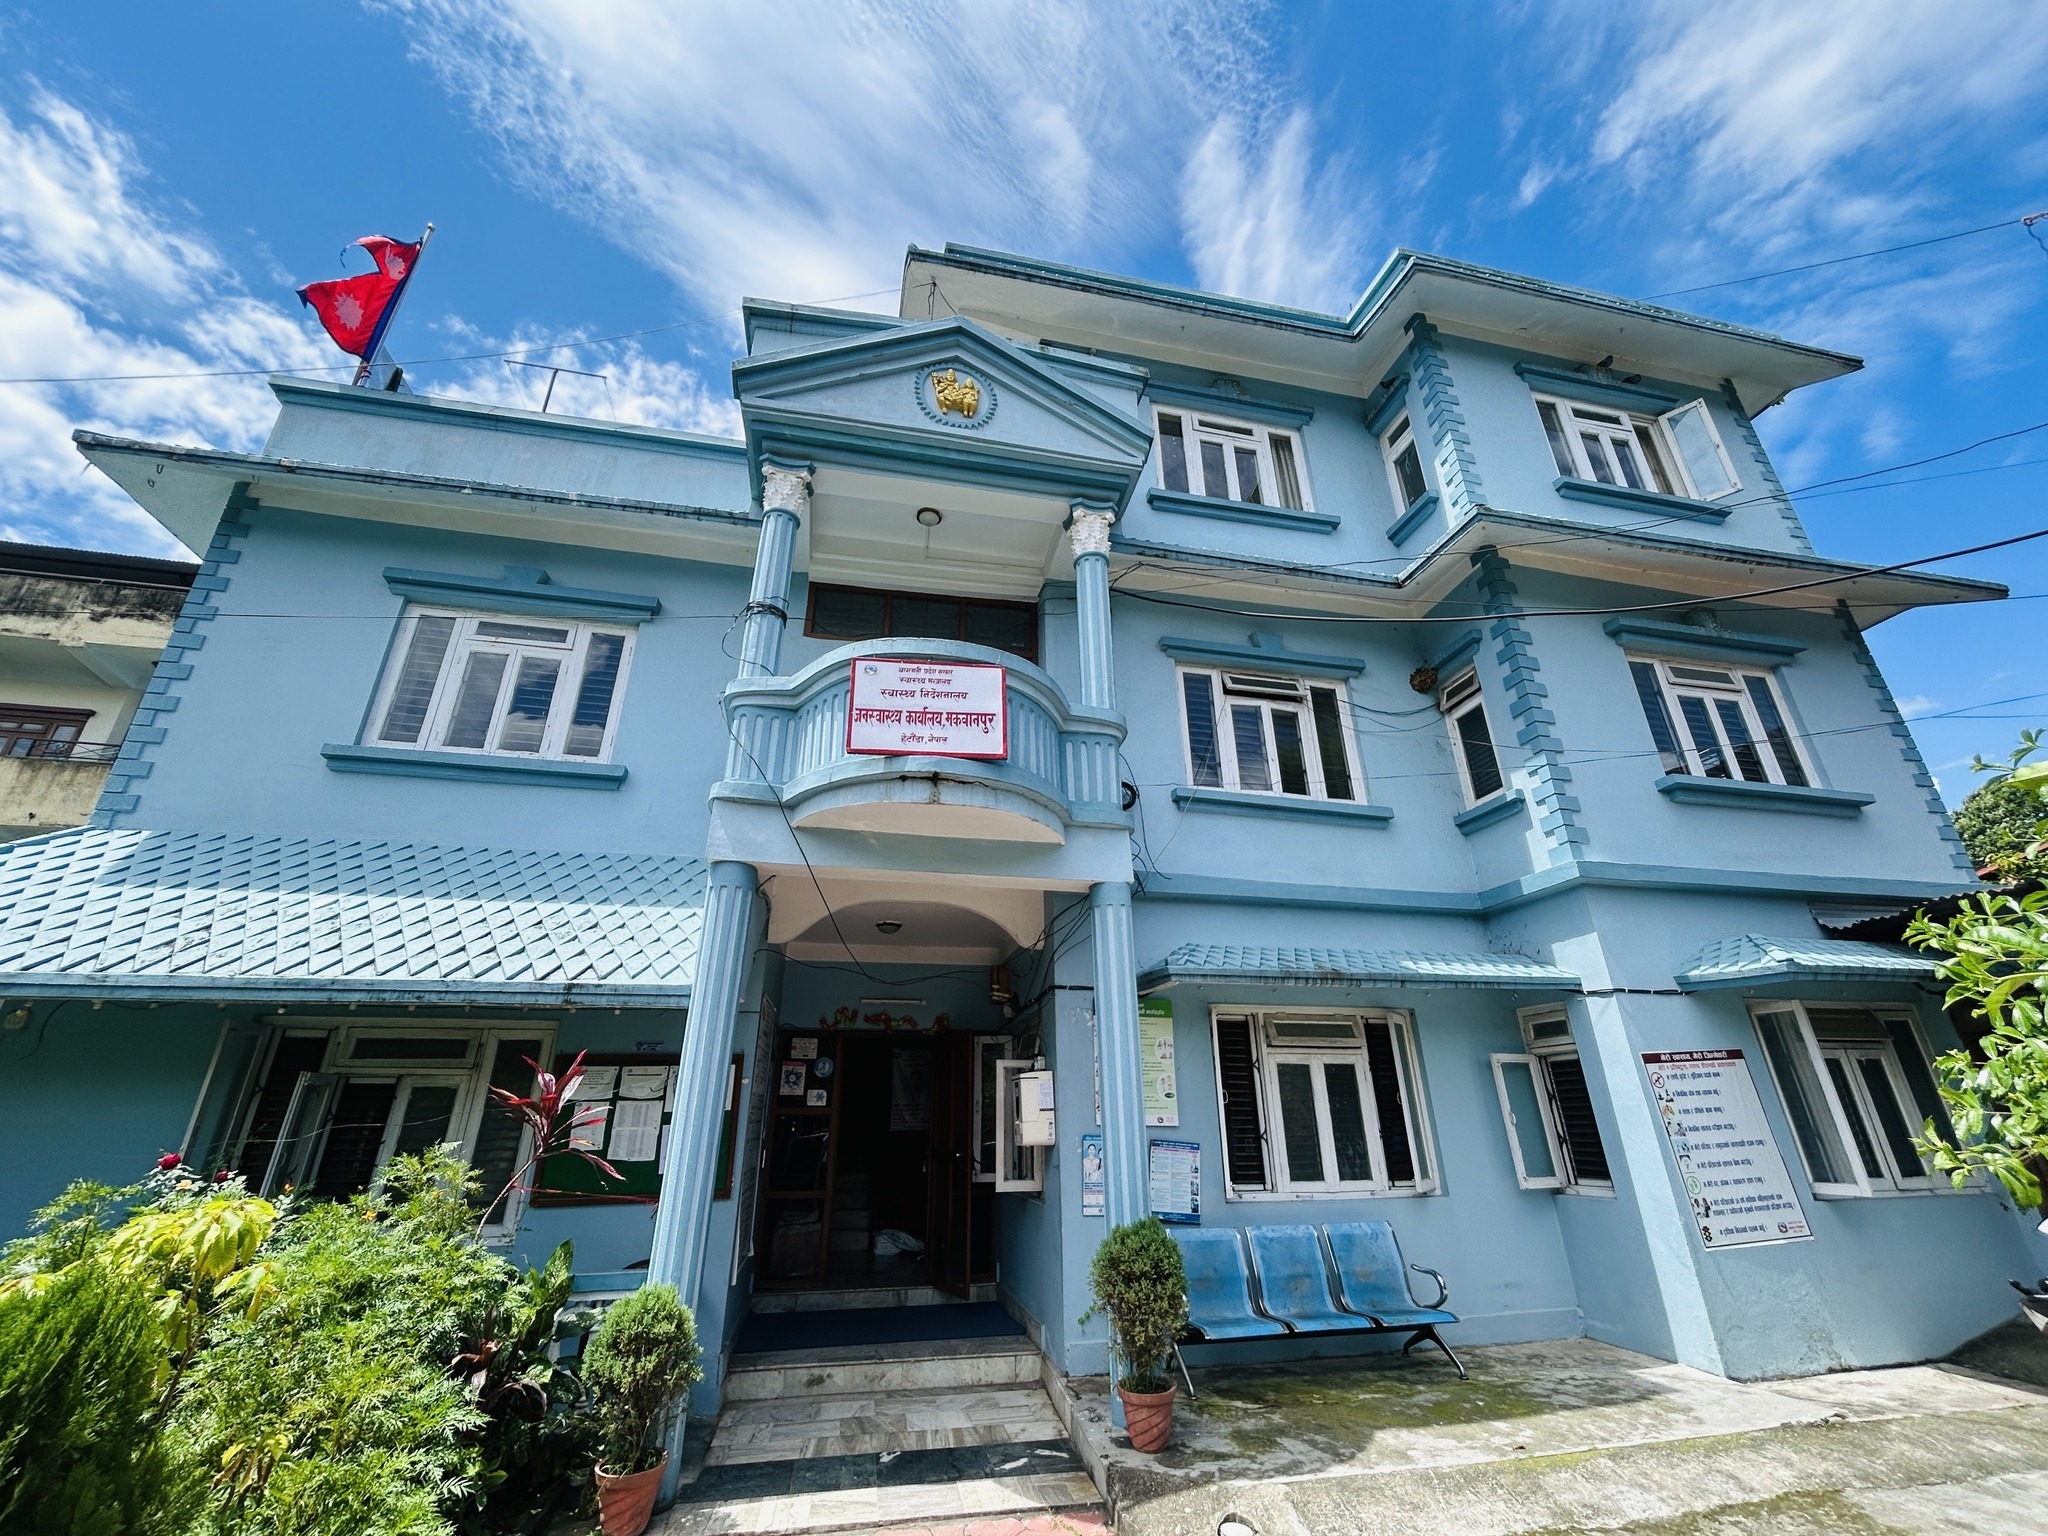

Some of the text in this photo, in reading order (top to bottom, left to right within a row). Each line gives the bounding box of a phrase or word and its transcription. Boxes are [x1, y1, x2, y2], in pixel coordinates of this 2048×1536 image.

[880, 688, 969, 702] स्वास्थ्य निर्देशनालय
[854, 707, 903, 727] जनस्वास्थ्य
